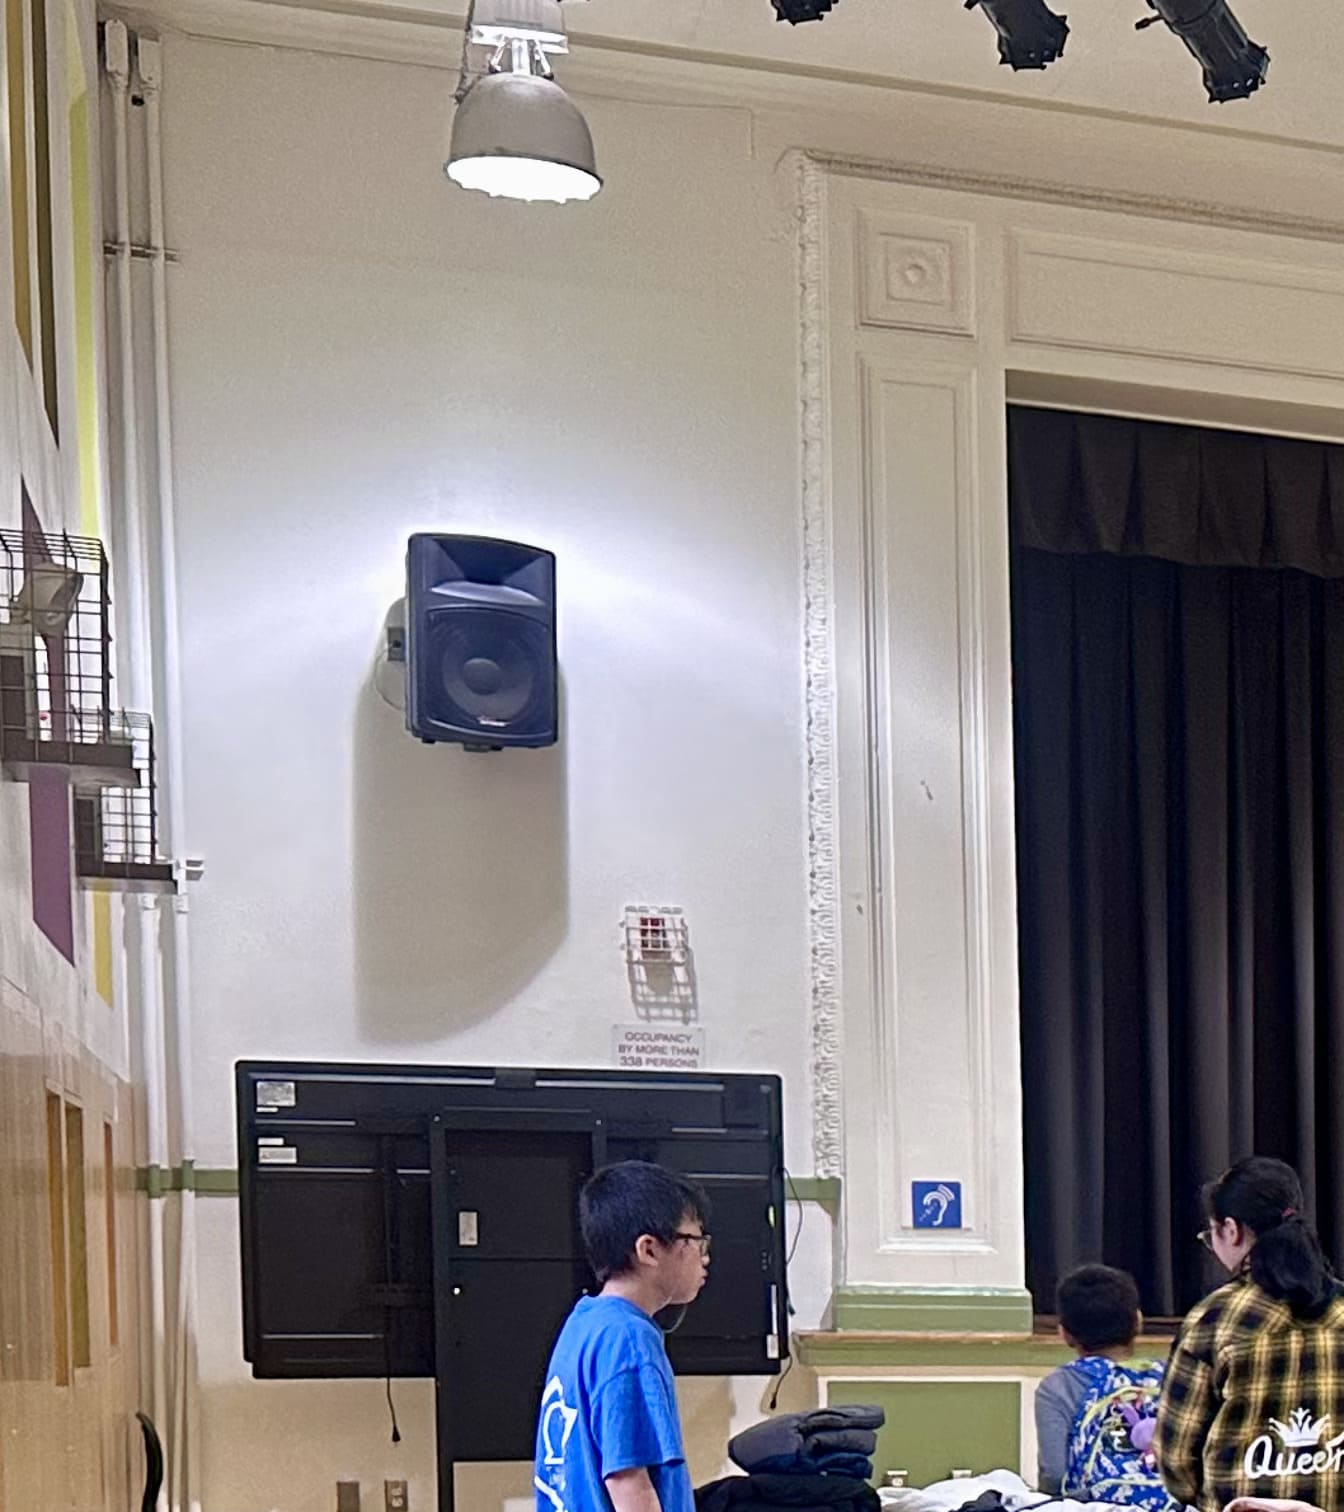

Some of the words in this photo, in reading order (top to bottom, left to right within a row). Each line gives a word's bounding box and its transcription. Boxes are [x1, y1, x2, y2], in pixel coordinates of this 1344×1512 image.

[625, 1032, 692, 1043] OCCUPANCY
[618, 1044, 633, 1054] BY
[636, 1045, 667, 1055] MORE
[671, 1046, 699, 1056] THAN
[620, 1056, 642, 1067] 338
